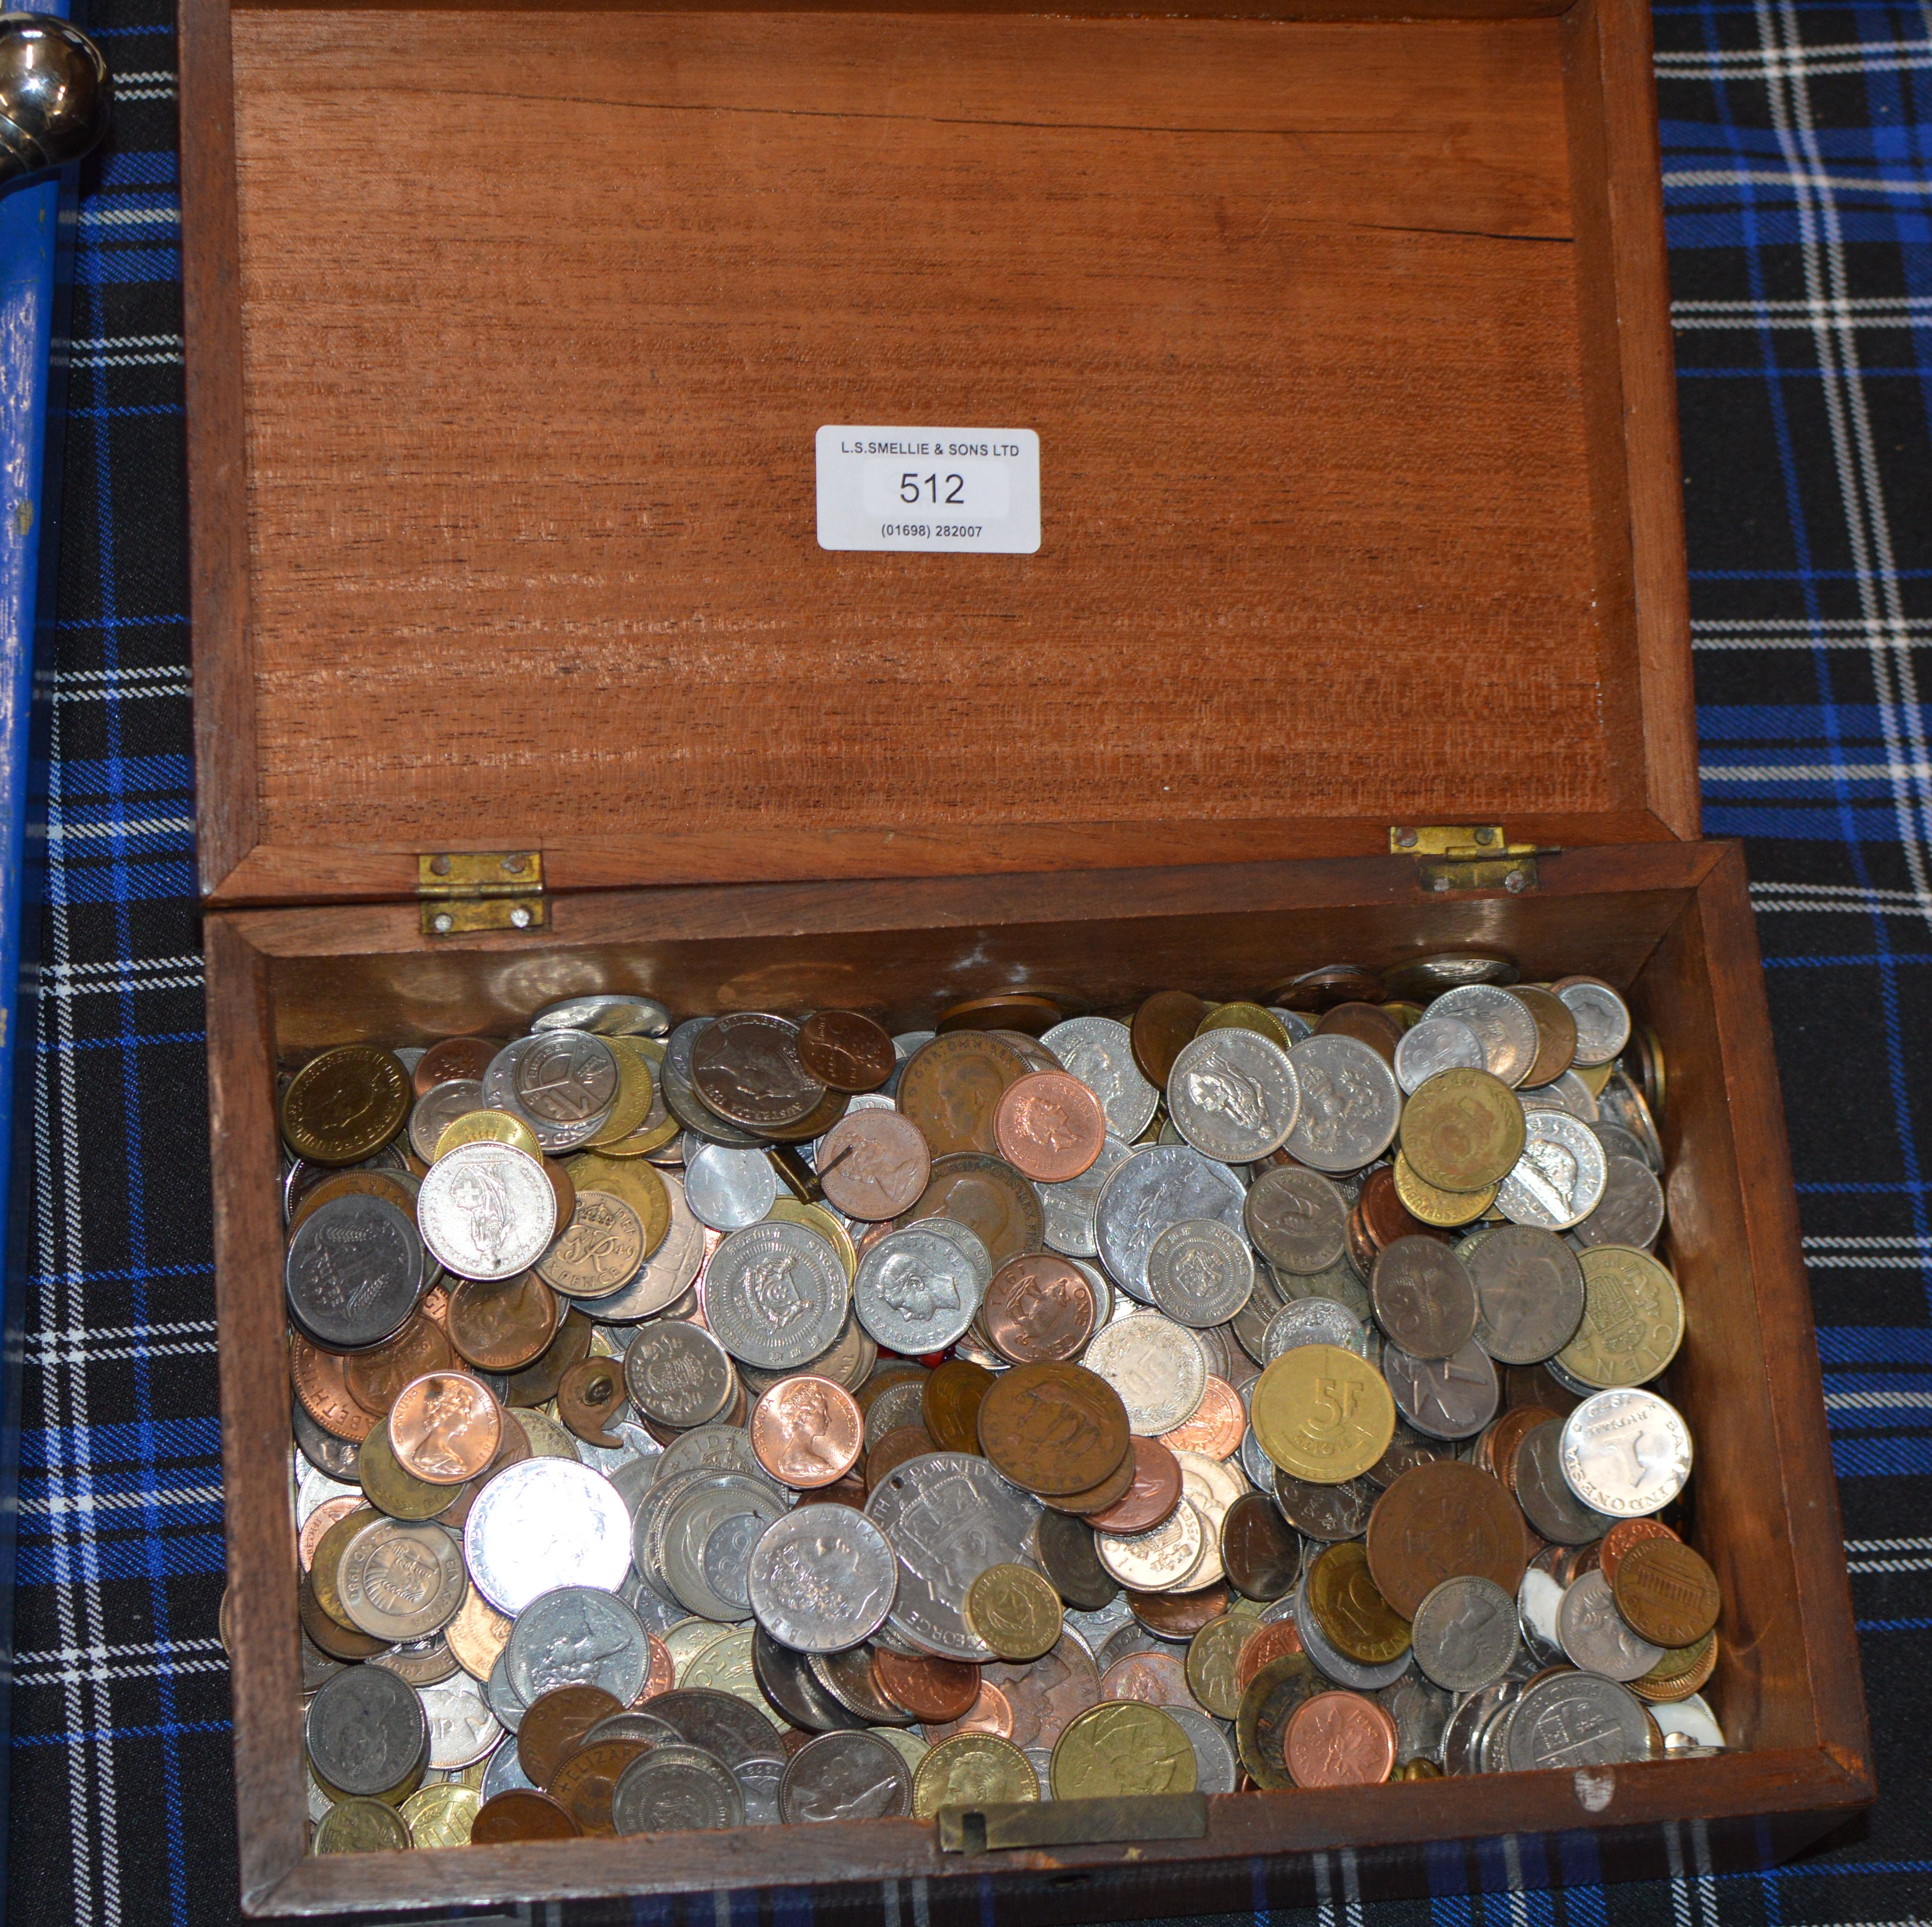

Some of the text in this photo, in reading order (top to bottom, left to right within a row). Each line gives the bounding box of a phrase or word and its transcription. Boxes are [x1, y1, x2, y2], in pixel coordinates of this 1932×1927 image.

[841, 442, 1019, 456] L.S.SMELLIE & SONS LTD
[899, 473, 964, 504] 512
[881, 524, 982, 539] (01698) 282007
[880, 1237, 937, 1258] GRATIA
[807, 1240, 842, 1312] SINGAPURA
[990, 1264, 1025, 1306] 1971
[709, 1280, 745, 1349] SINGAPORE
[734, 1294, 753, 1322] 1993
[1025, 1287, 1089, 1358] ONE CENT
[1595, 1324, 1673, 1380] CIEN
[1586, 1394, 1632, 1417] 1970
[754, 1397, 775, 1455] BERMUDA
[833, 1392, 860, 1448] ELIZABETH
[1565, 1444, 1671, 1510] INDONESIA
[348, 1567, 361, 1598] 1981
[445, 1559, 463, 1583] EIN
